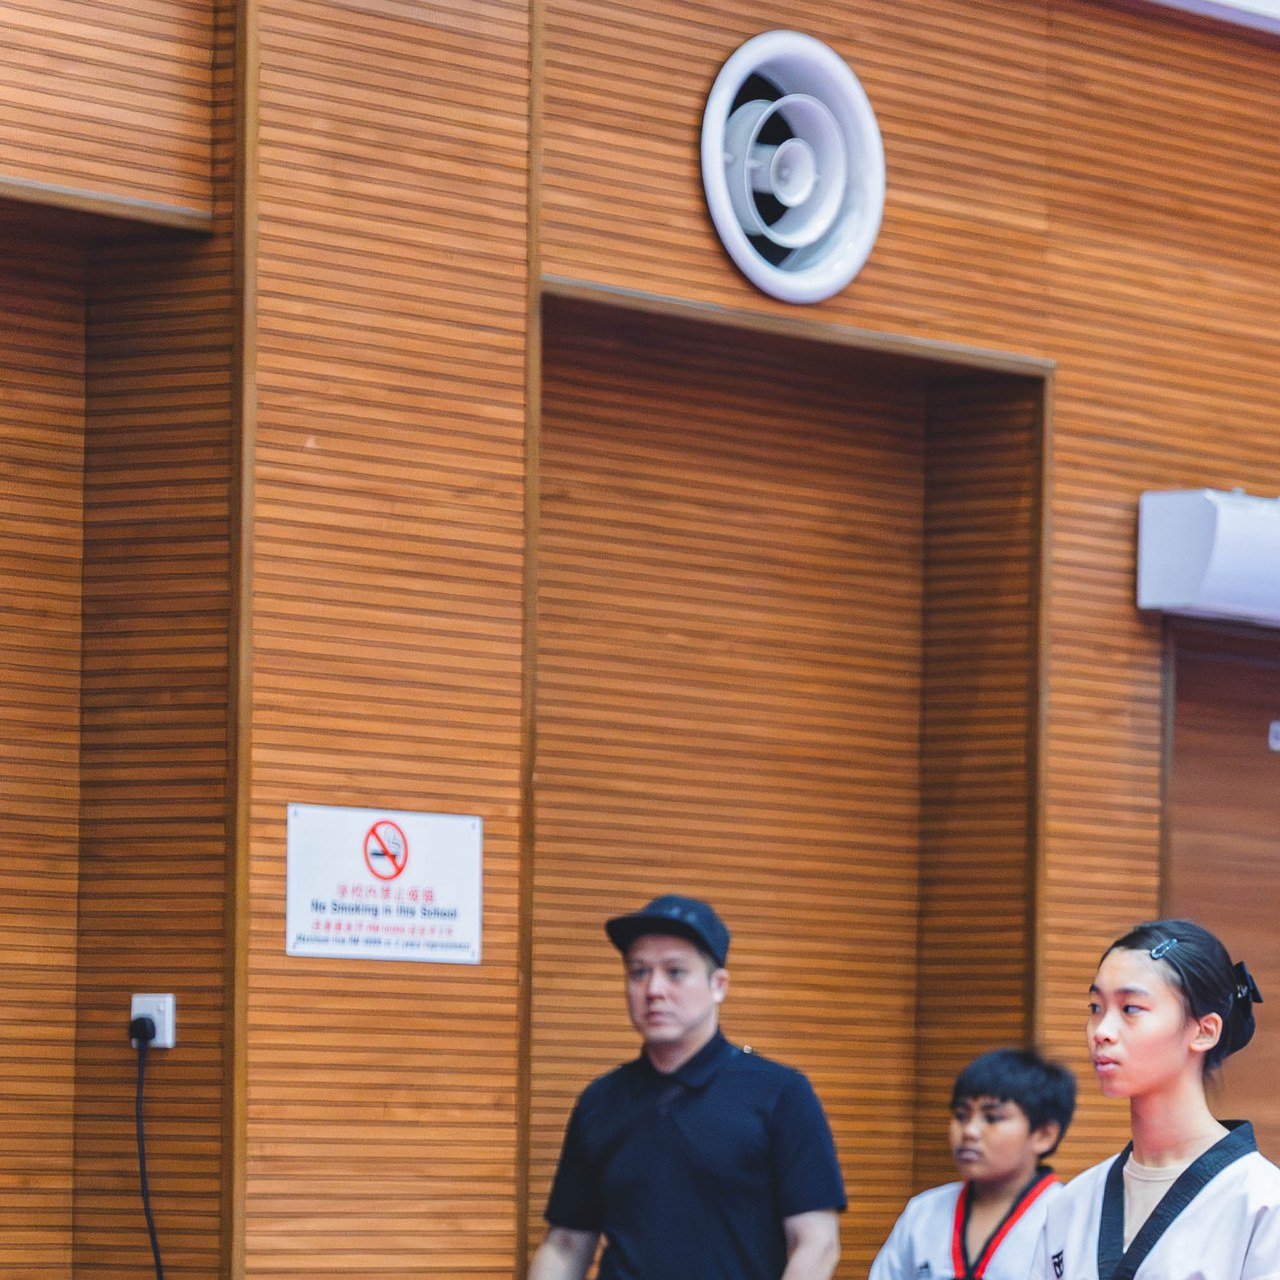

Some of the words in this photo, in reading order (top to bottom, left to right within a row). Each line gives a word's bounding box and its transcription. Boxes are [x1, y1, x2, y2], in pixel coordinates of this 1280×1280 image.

[311, 898, 326, 913] No
[331, 901, 378, 916] Smoking
[420, 905, 457, 919] School
